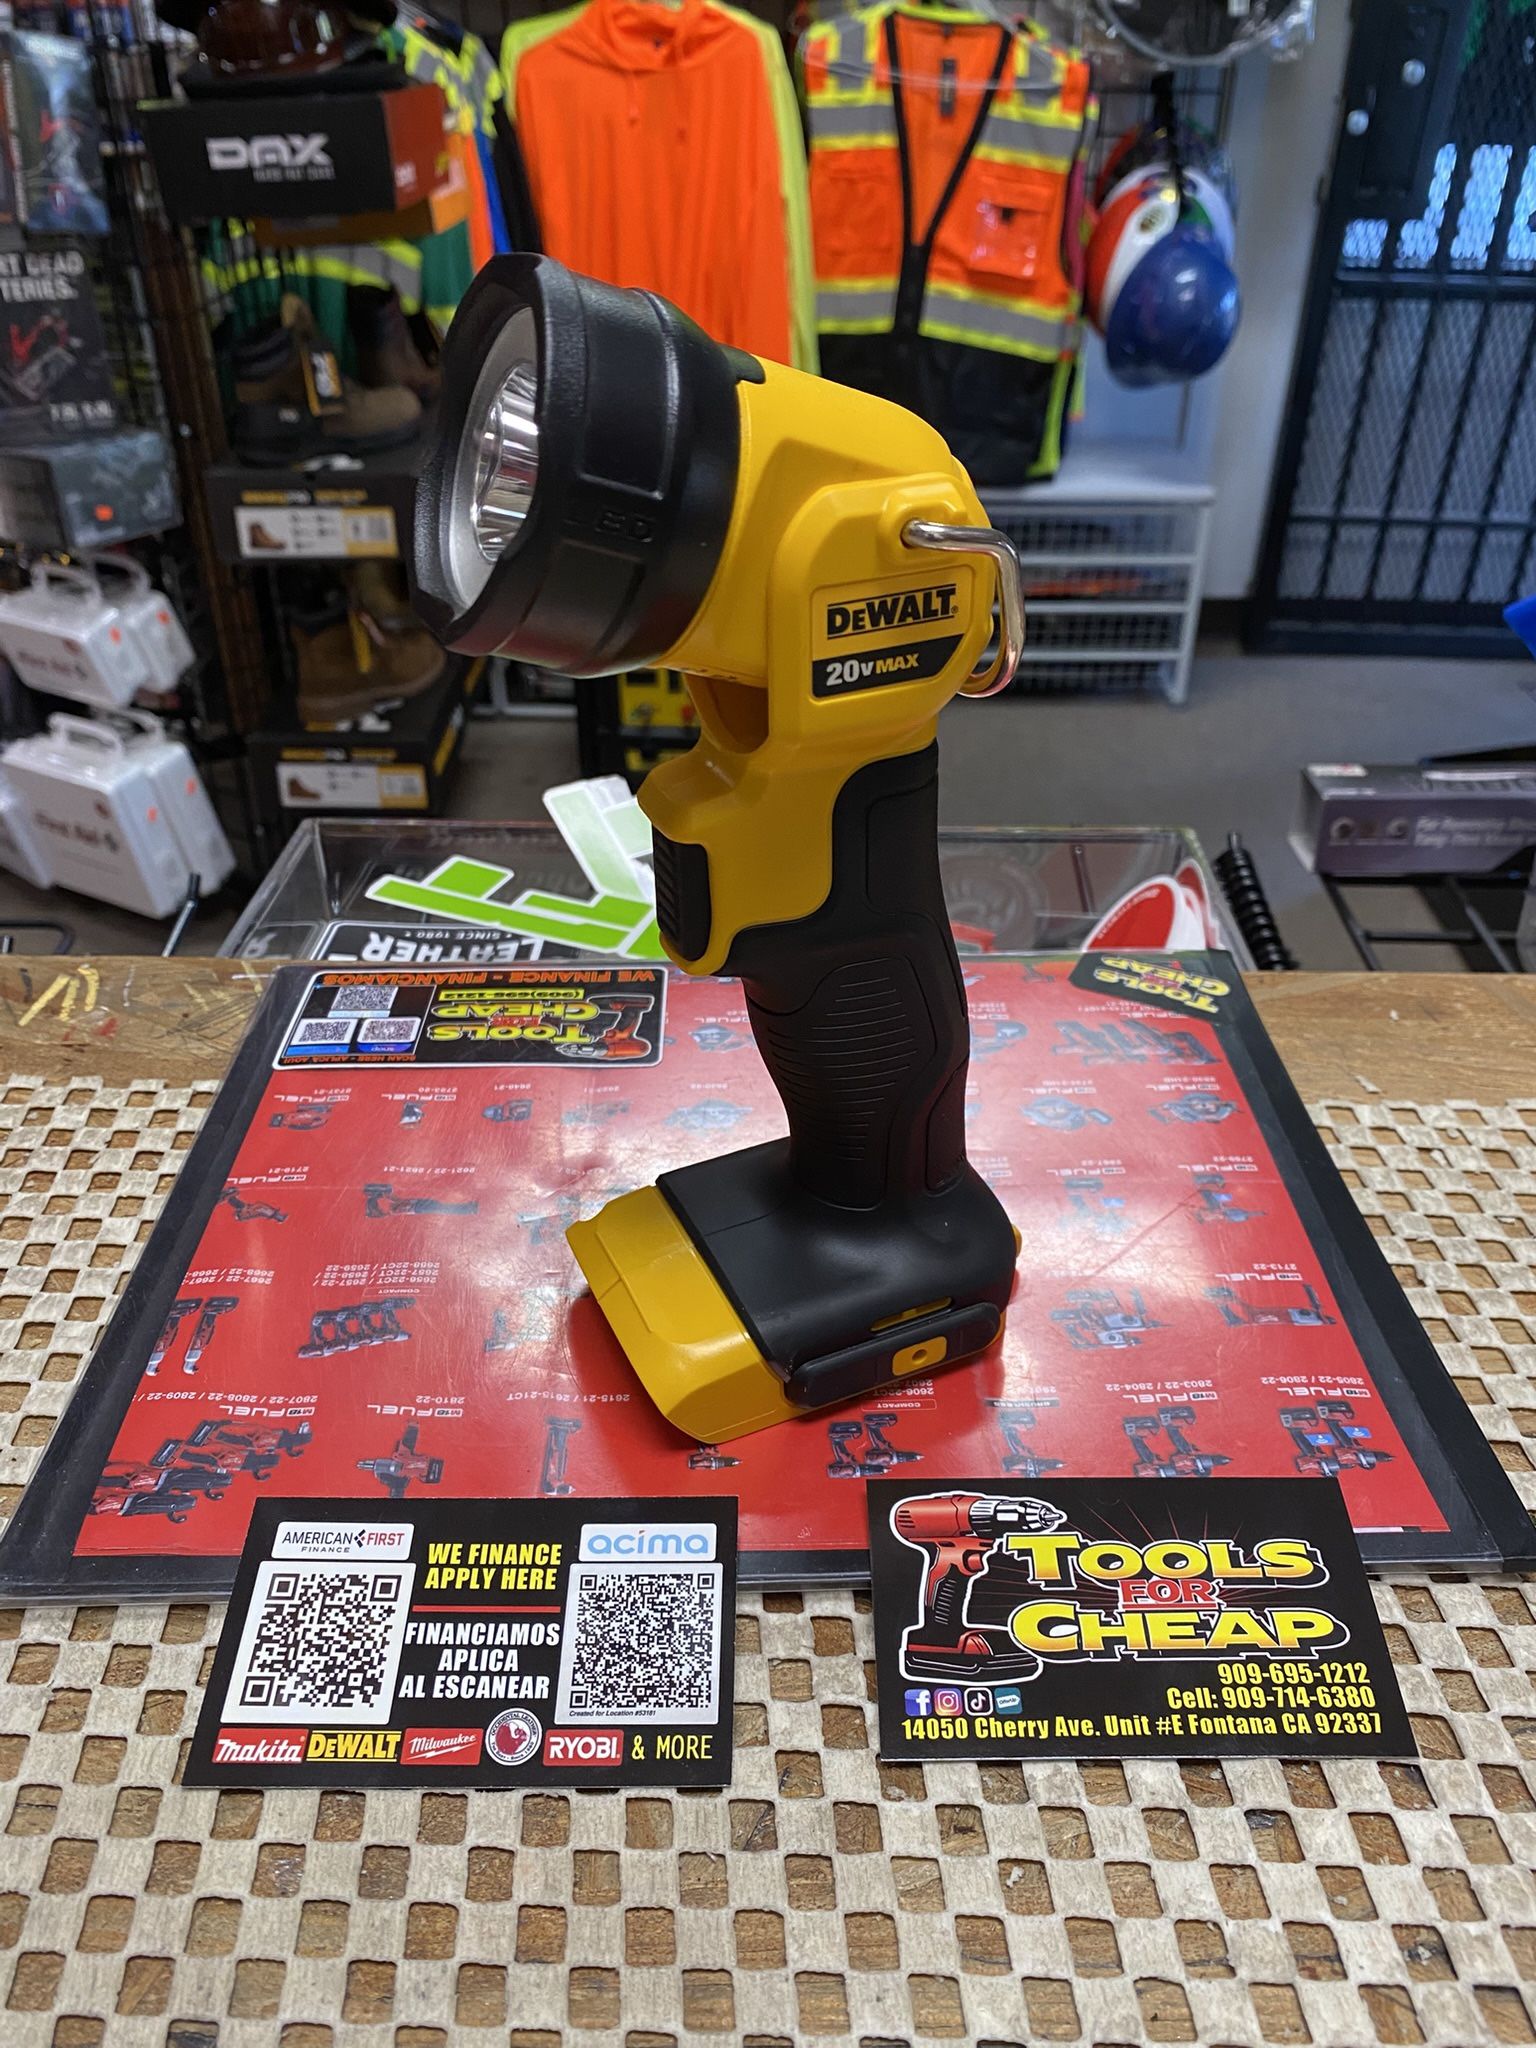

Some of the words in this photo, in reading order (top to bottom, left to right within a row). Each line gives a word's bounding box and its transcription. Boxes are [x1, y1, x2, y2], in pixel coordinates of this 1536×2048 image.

[206, 133, 333, 170] DAX
[455, 931, 501, 940] SINCE
[362, 931, 545, 963] LEATHER
[322, 972, 487, 986] FINANCIAMOS
[509, 971, 611, 984] FINANCE
[618, 971, 656, 983] WE
[1101, 956, 1229, 997] CHEAP
[1094, 969, 1219, 1014] TOOLS
[434, 1001, 600, 1020] CHEAP
[430, 1025, 592, 1043] TOOLS
[1215, 1272, 1276, 1281] FUEL
[1105, 1382, 1153, 1392] 2804-22
[1164, 1379, 1213, 1390] 2803-22
[1277, 1386, 1343, 1396] FUEL
[147, 1392, 197, 1401] 2809-22
[207, 1392, 258, 1402] 2808-22
[269, 1395, 319, 1404] 2807-22
[415, 1395, 465, 1404] 2810-22
[506, 1391, 570, 1402] 2615-21CT
[583, 1393, 630, 1402] 2615-21
[1122, 1392, 1189, 1403] FUEL
[219, 1405, 286, 1417] FUEL
[367, 1404, 433, 1417] FUEL
[282, 1531, 353, 1545] AMERICAN
[367, 1532, 405, 1546] FIRST
[587, 1530, 709, 1554] acima
[428, 1543, 463, 1565] WE
[468, 1543, 562, 1566] FINANCE
[1006, 1534, 1317, 1581] TOOLS
[424, 1567, 496, 1589] APPLY
[501, 1568, 558, 1590] HERE
[1118, 1578, 1216, 1605] FOR
[404, 1622, 561, 1646] FINANCIAMOS
[1011, 1602, 1336, 1651] CHEAP
[437, 1649, 519, 1672] APLICA
[1217, 1662, 1371, 1684] 909-695-1212
[398, 1675, 426, 1698] AL
[432, 1675, 550, 1699] ESCANEAR
[1166, 1687, 1219, 1709] Cell:
[1221, 1686, 1376, 1709] 909-714-6380
[901, 1717, 969, 1739] 14050
[974, 1716, 1049, 1739] Cherry
[1055, 1715, 1100, 1737] Ave.
[1104, 1714, 1151, 1736] Unit
[1155, 1714, 1182, 1735] #E
[1188, 1714, 1277, 1735] Fontana
[1281, 1713, 1312, 1734] CA
[1315, 1712, 1382, 1734] 92337
[408, 1733, 476, 1753] Milwaukee
[549, 1737, 618, 1759] RYOBI
[631, 1735, 645, 1760] &
[656, 1735, 713, 1760] MORE
